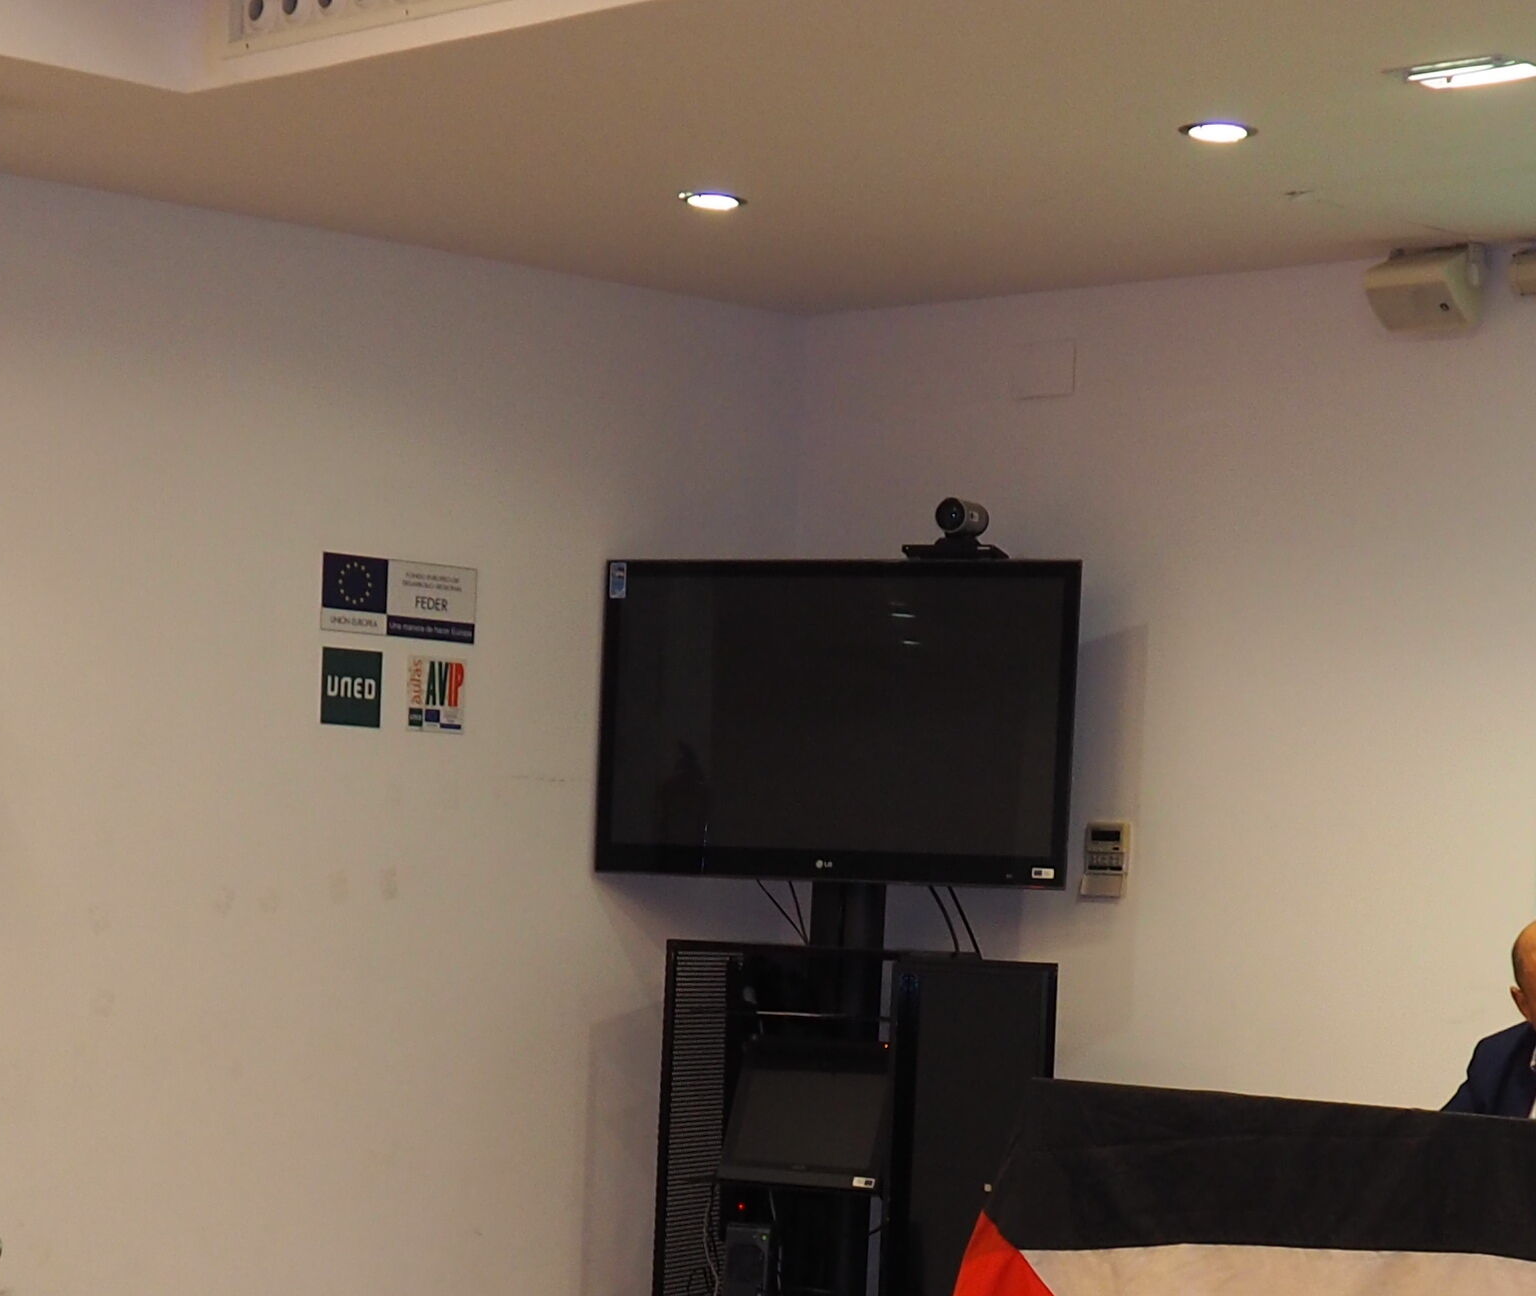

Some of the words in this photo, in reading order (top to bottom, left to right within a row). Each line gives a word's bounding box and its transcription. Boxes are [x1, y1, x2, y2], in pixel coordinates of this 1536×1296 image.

[415, 595, 448, 611] FEDER
[327, 675, 376, 700] UNED
[425, 660, 464, 707] AVIP
